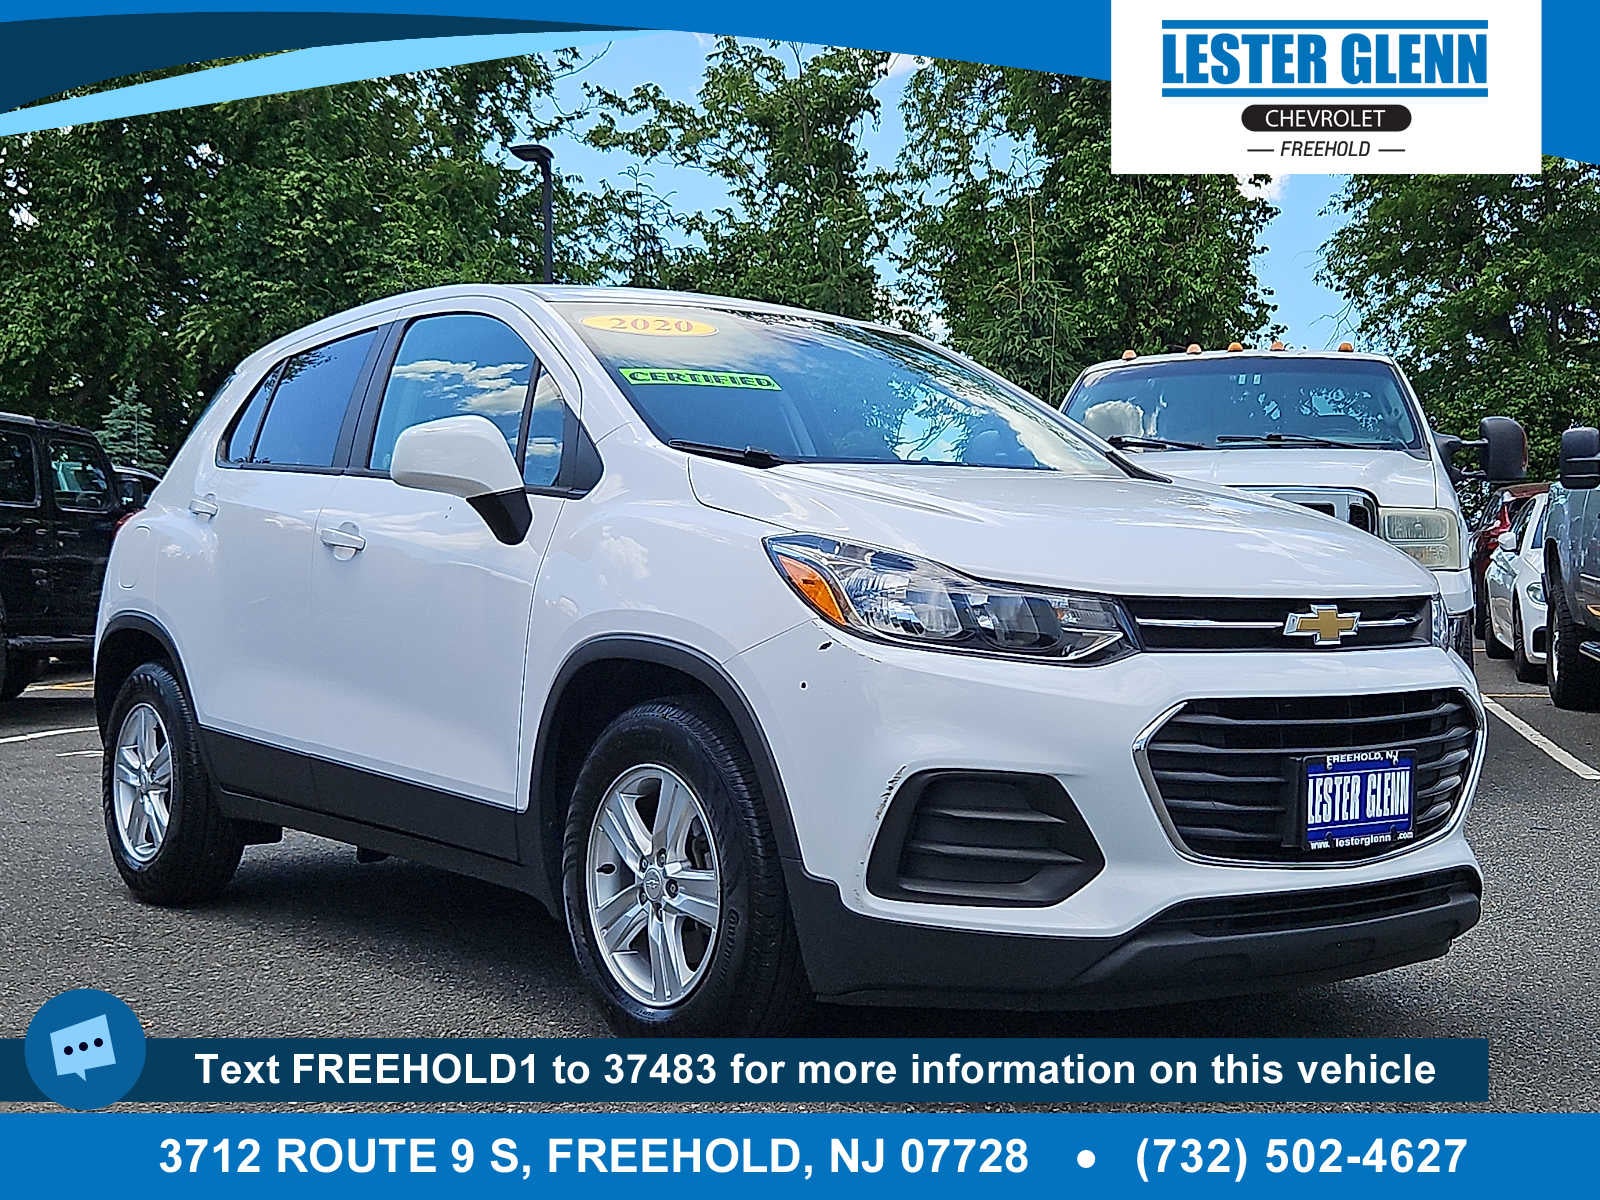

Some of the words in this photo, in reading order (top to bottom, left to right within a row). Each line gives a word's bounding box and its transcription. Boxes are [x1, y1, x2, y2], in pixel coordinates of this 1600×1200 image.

[610, 317, 694, 333] 2020
[628, 371, 775, 388] CERTIFIED
[1326, 752, 1384, 764] FREEHOLD,
[1307, 775, 1361, 825] LESTER
[1366, 771, 1409, 818] GLENN
